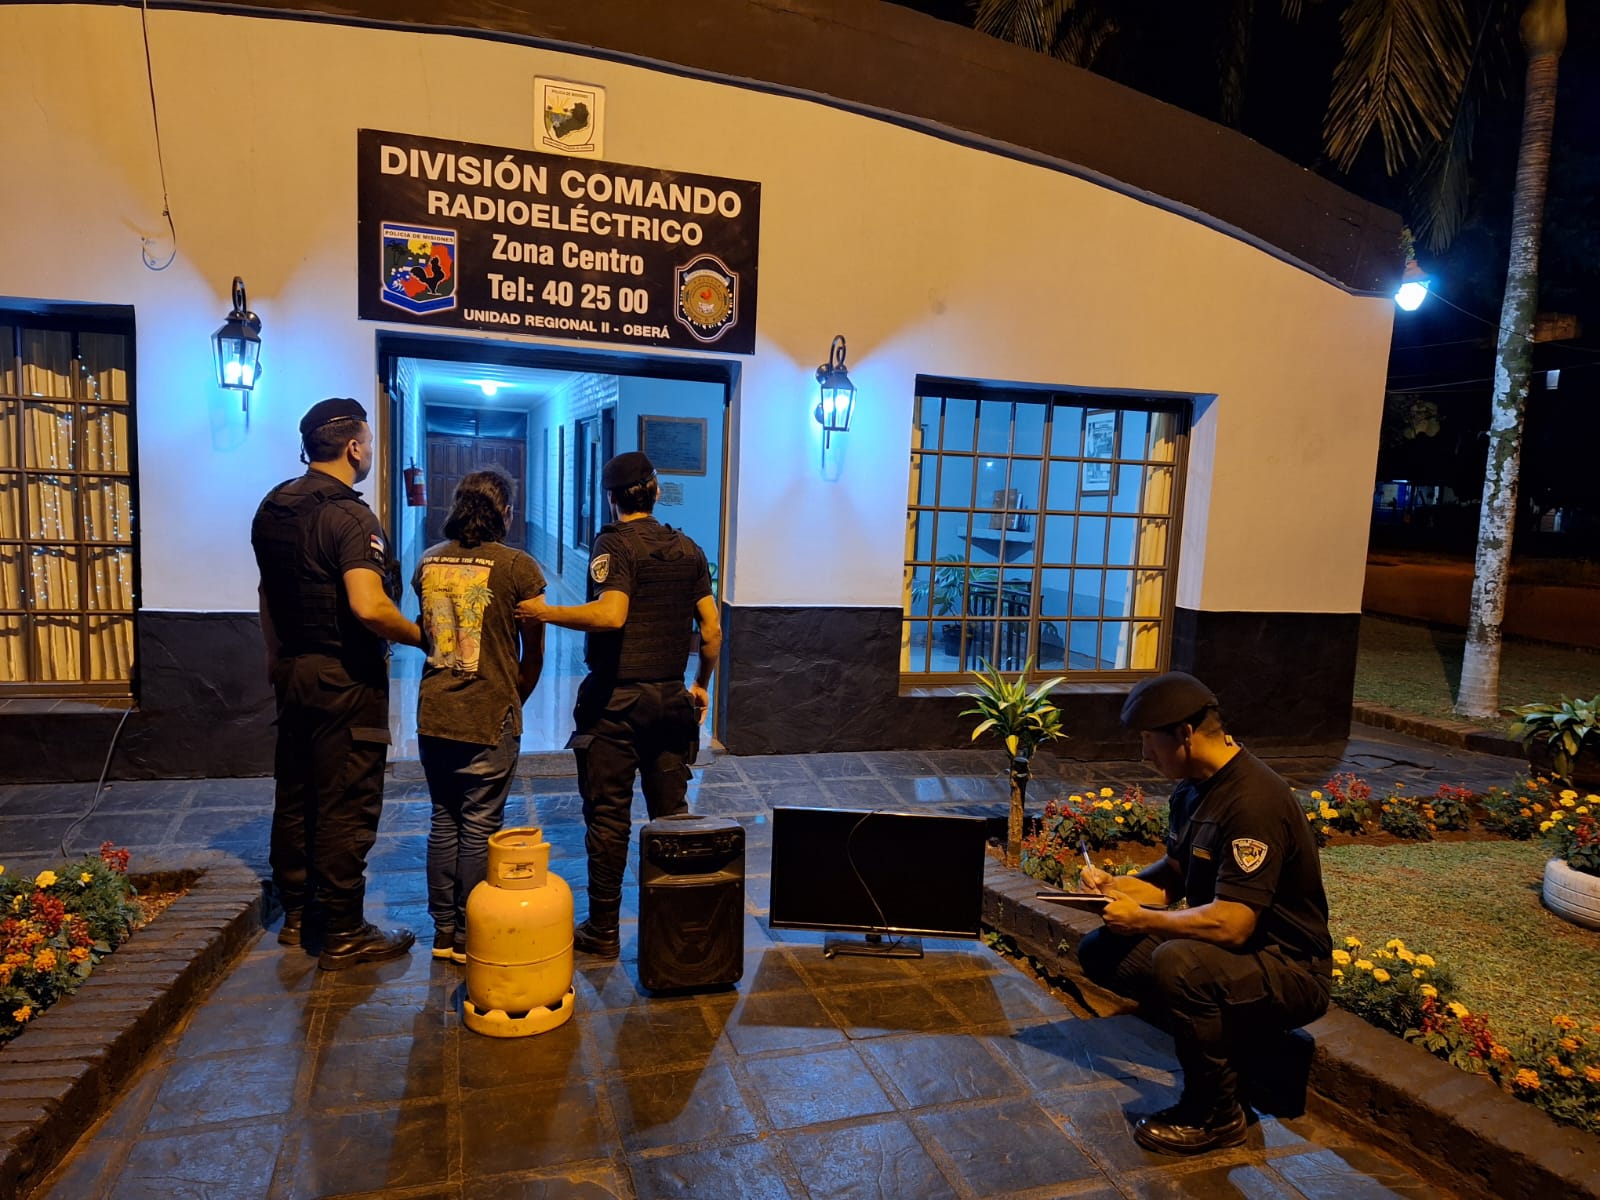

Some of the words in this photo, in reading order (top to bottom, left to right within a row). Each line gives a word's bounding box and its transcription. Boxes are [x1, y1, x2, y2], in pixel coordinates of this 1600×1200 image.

[380, 144, 548, 195] DIVISIÓN
[560, 169, 742, 218] COMANDO
[384, 230, 411, 238] POLICIA
[423, 235, 454, 243] MISIONES
[427, 190, 703, 246] RADIOELÉCTRICO
[492, 233, 554, 266] Zona
[562, 241, 644, 276] Centro
[487, 273, 534, 303] Tel:
[541, 280, 573, 307] 40
[581, 284, 611, 311] 25
[618, 287, 649, 315] 00
[463, 308, 521, 325] UNIDAD
[525, 314, 597, 333] REGIONAL
[623, 323, 671, 339] OBERÁ
